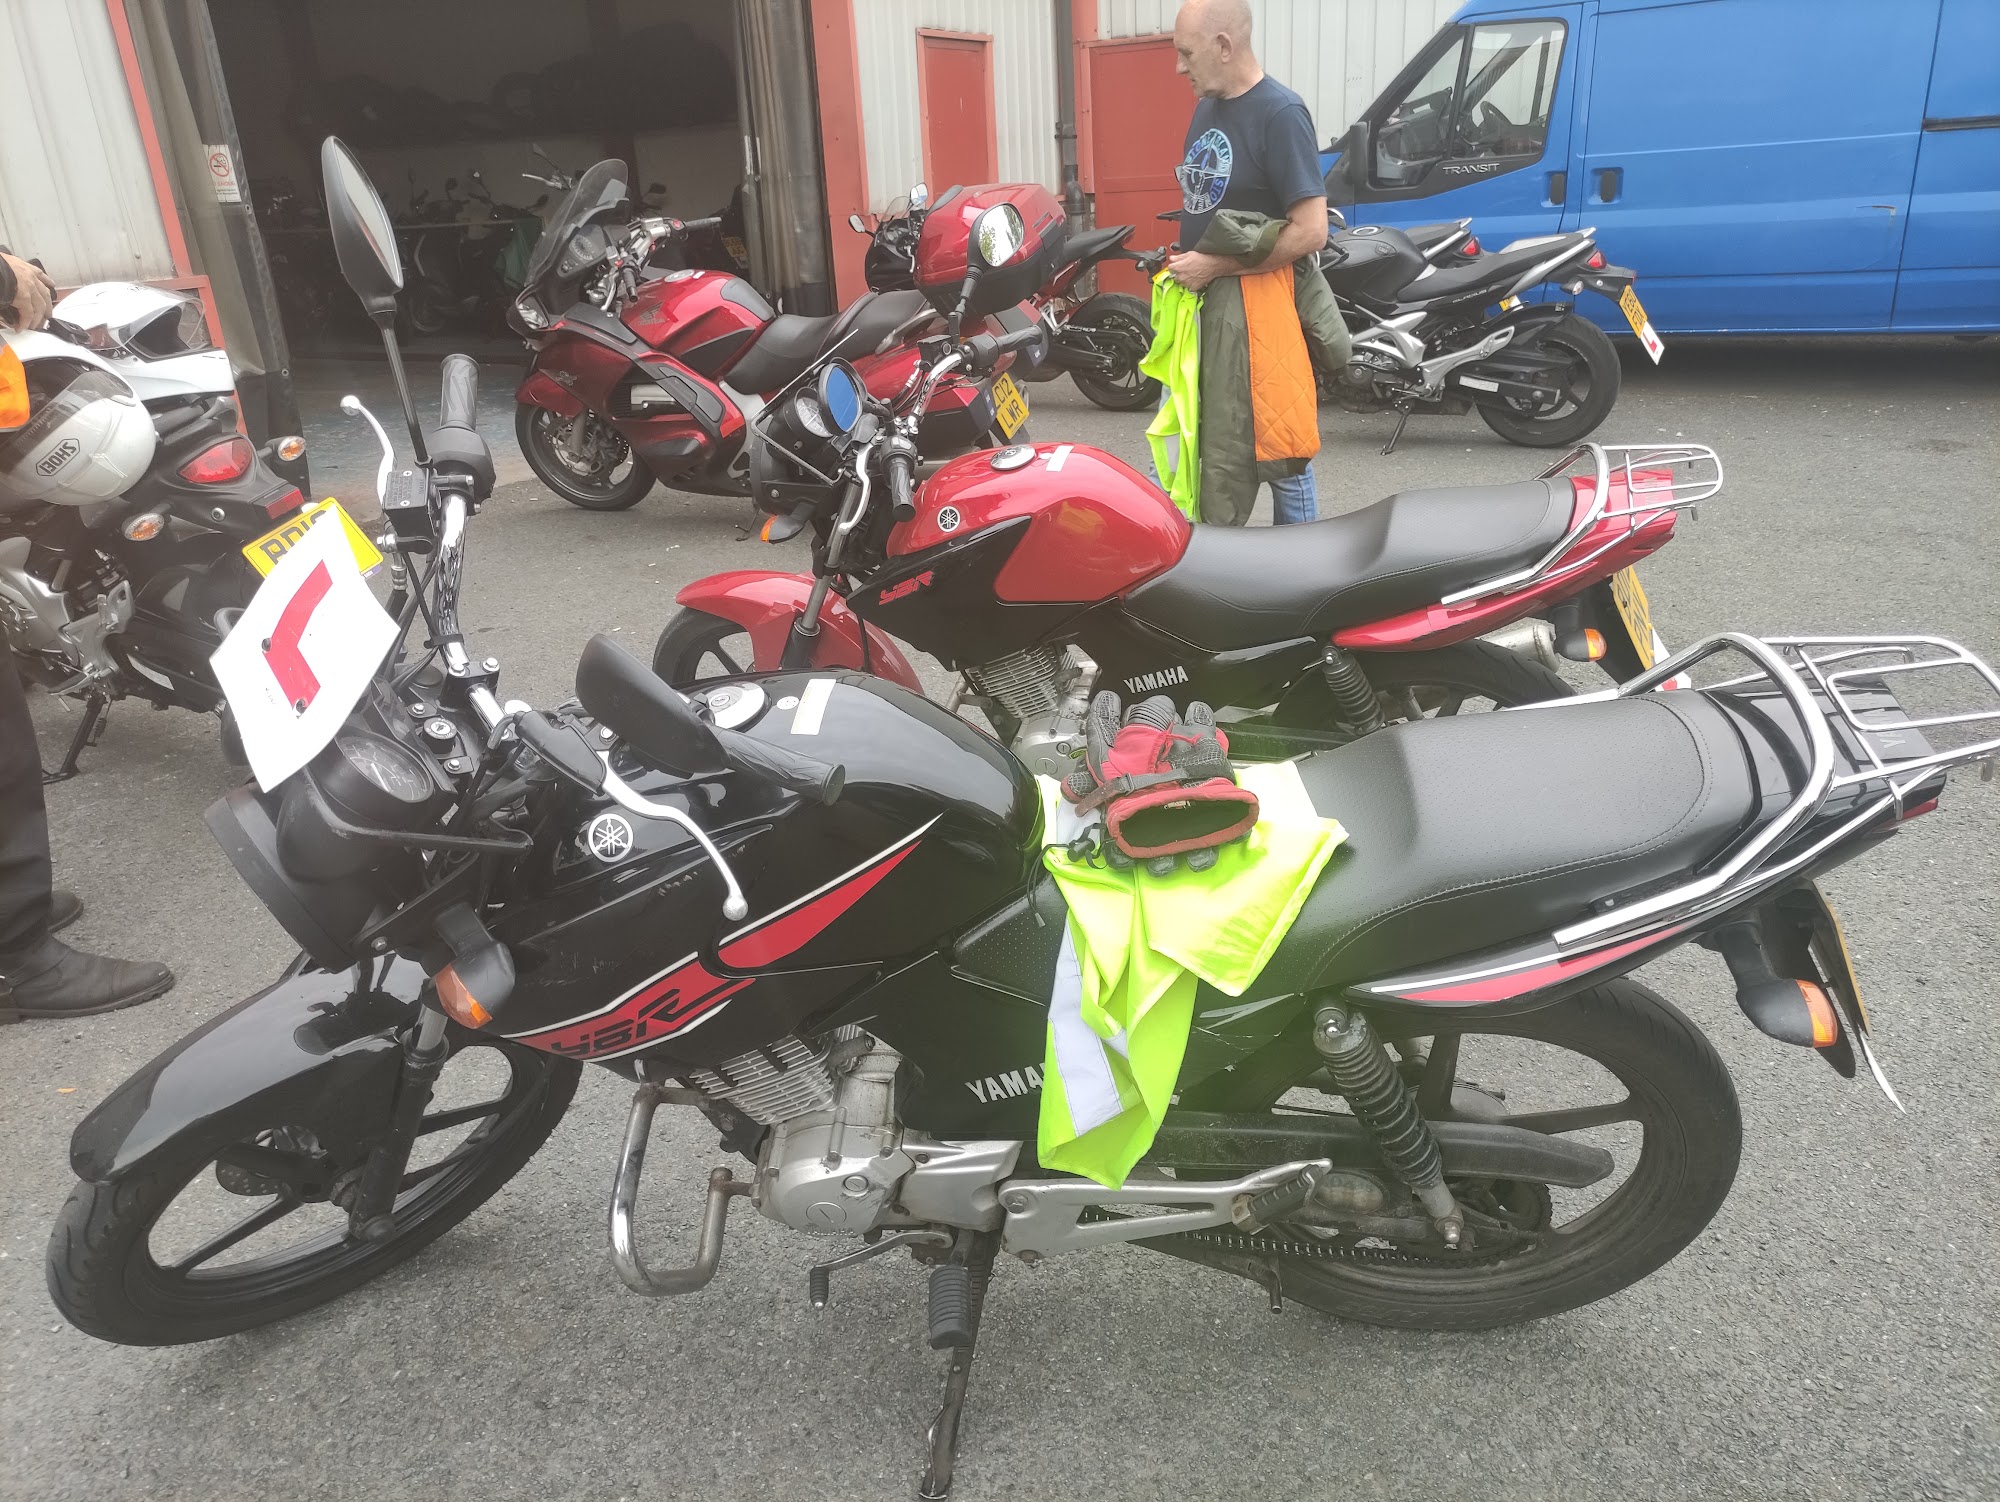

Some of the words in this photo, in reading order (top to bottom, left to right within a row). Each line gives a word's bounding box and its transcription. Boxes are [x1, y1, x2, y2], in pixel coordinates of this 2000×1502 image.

[1442, 163, 1500, 174] TRANSIT
[995, 377, 1013, 408] C12
[1001, 398, 1023, 429] LWR
[38, 441, 77, 475] SHOEI
[879, 570, 935, 606] YBR
[1123, 665, 1189, 694] YAMAHA
[550, 985, 700, 1054] YBR
[964, 1062, 1046, 1104] YAMA
